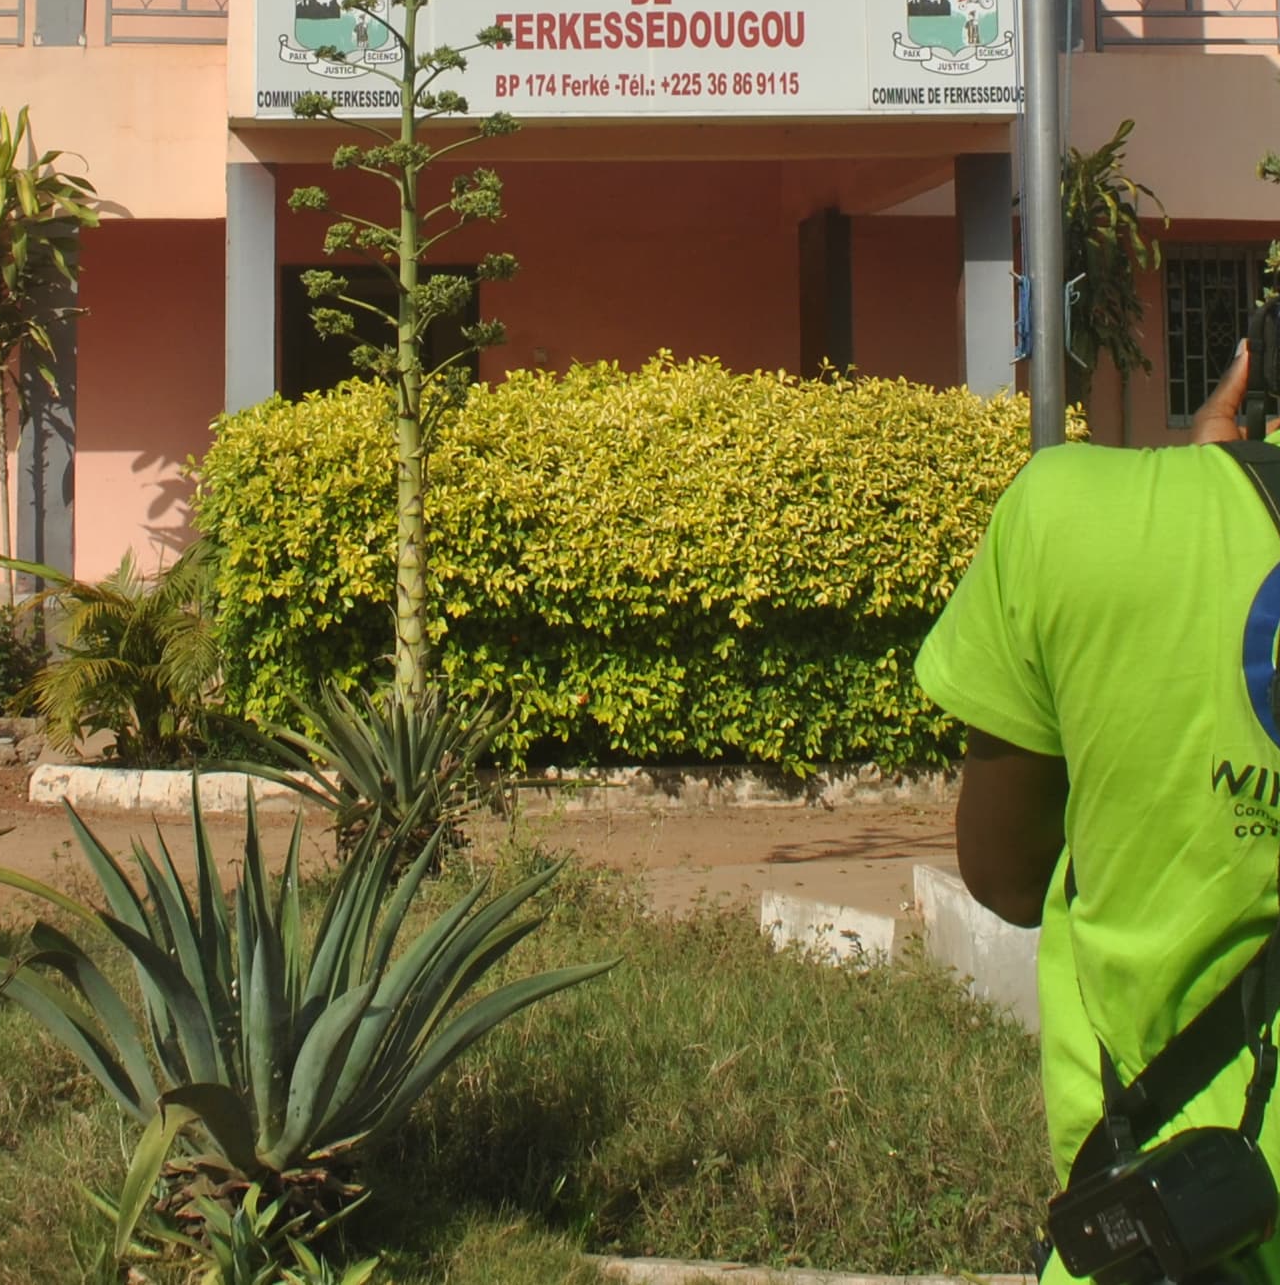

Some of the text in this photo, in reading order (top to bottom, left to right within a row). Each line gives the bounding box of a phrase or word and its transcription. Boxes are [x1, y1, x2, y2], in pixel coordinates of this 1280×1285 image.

[496, 10, 805, 51] FERKESSEDOUGOU
[289, 52, 307, 60] PAIX
[367, 52, 399, 61] SCIENCE
[903, 49, 920, 58] PAIX
[978, 49, 1009, 57] SCIENCE
[324, 66, 357, 75] JUSTICE
[937, 63, 970, 71] JUSTICE
[496, 74, 520, 97] BP
[526, 74, 557, 96] 174
[562, 73, 610, 96] Ferké
[661, 73, 702, 95] +225
[707, 72, 728, 95] 36
[732, 72, 753, 95] 86
[872, 85, 1024, 104] COMMUNE DE FERKESSEDOUG
